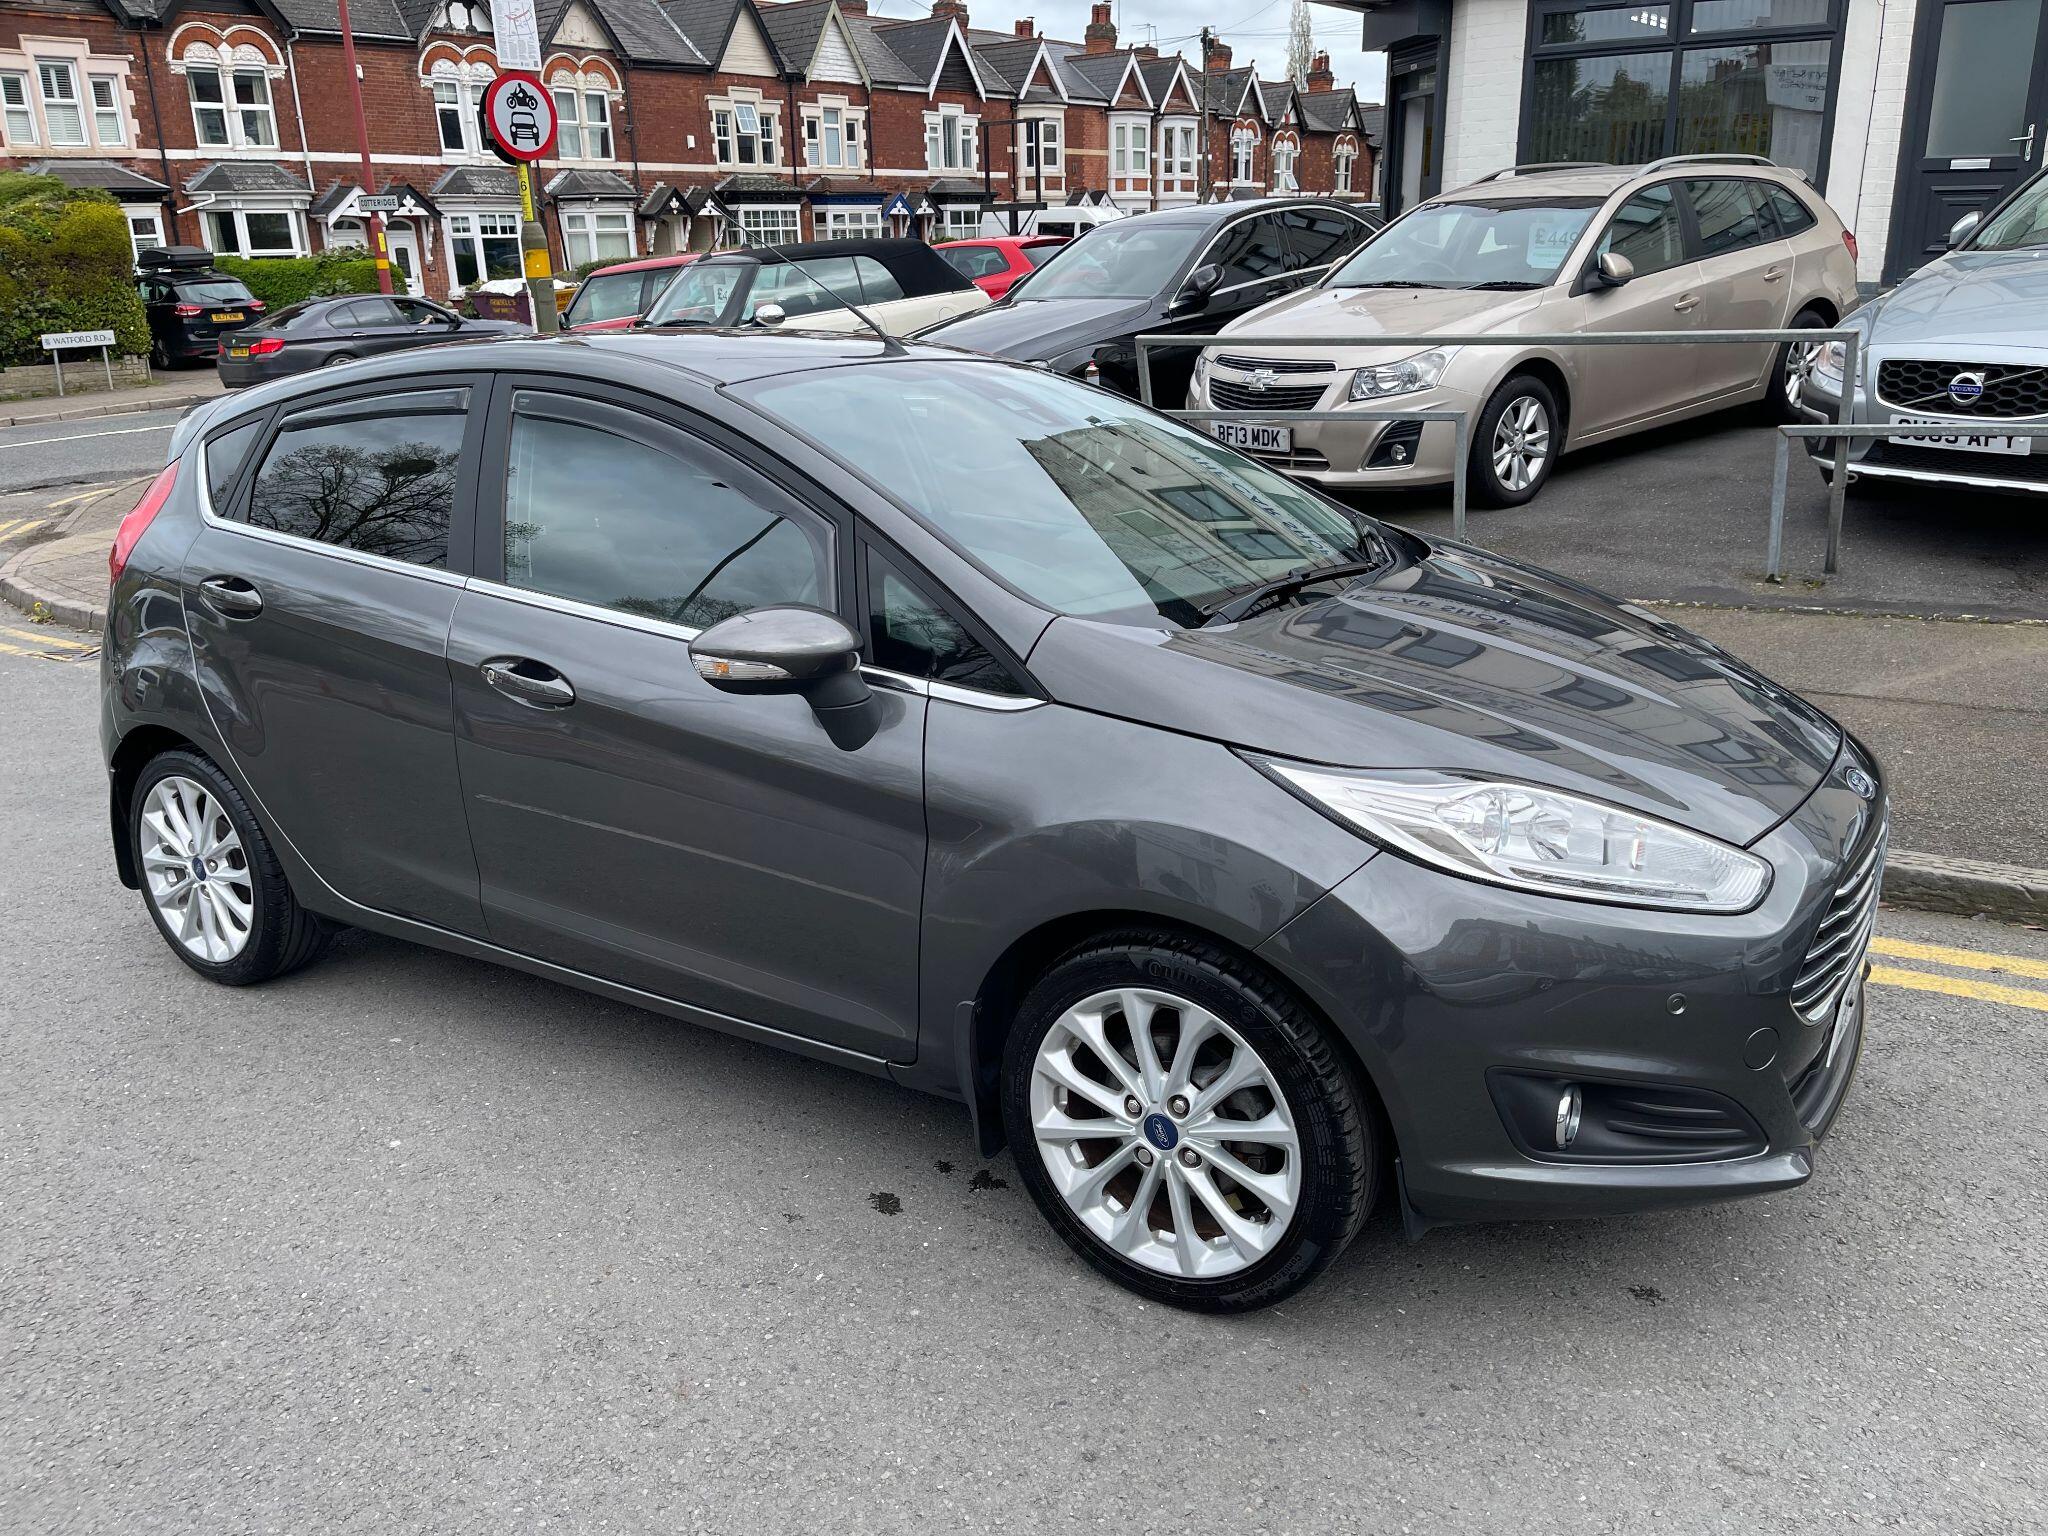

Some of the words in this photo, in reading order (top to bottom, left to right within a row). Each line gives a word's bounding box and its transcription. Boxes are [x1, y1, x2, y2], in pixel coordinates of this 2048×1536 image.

[520, 180, 528, 192] 6
[360, 198, 397, 207] COTTERIDGE
[52, 335, 92, 345] WATFORD
[93, 334, 106, 342] RD
[1950, 385, 1980, 393] VOLVO
[1217, 424, 1248, 445] BF13
[1251, 427, 1281, 448] MDK
